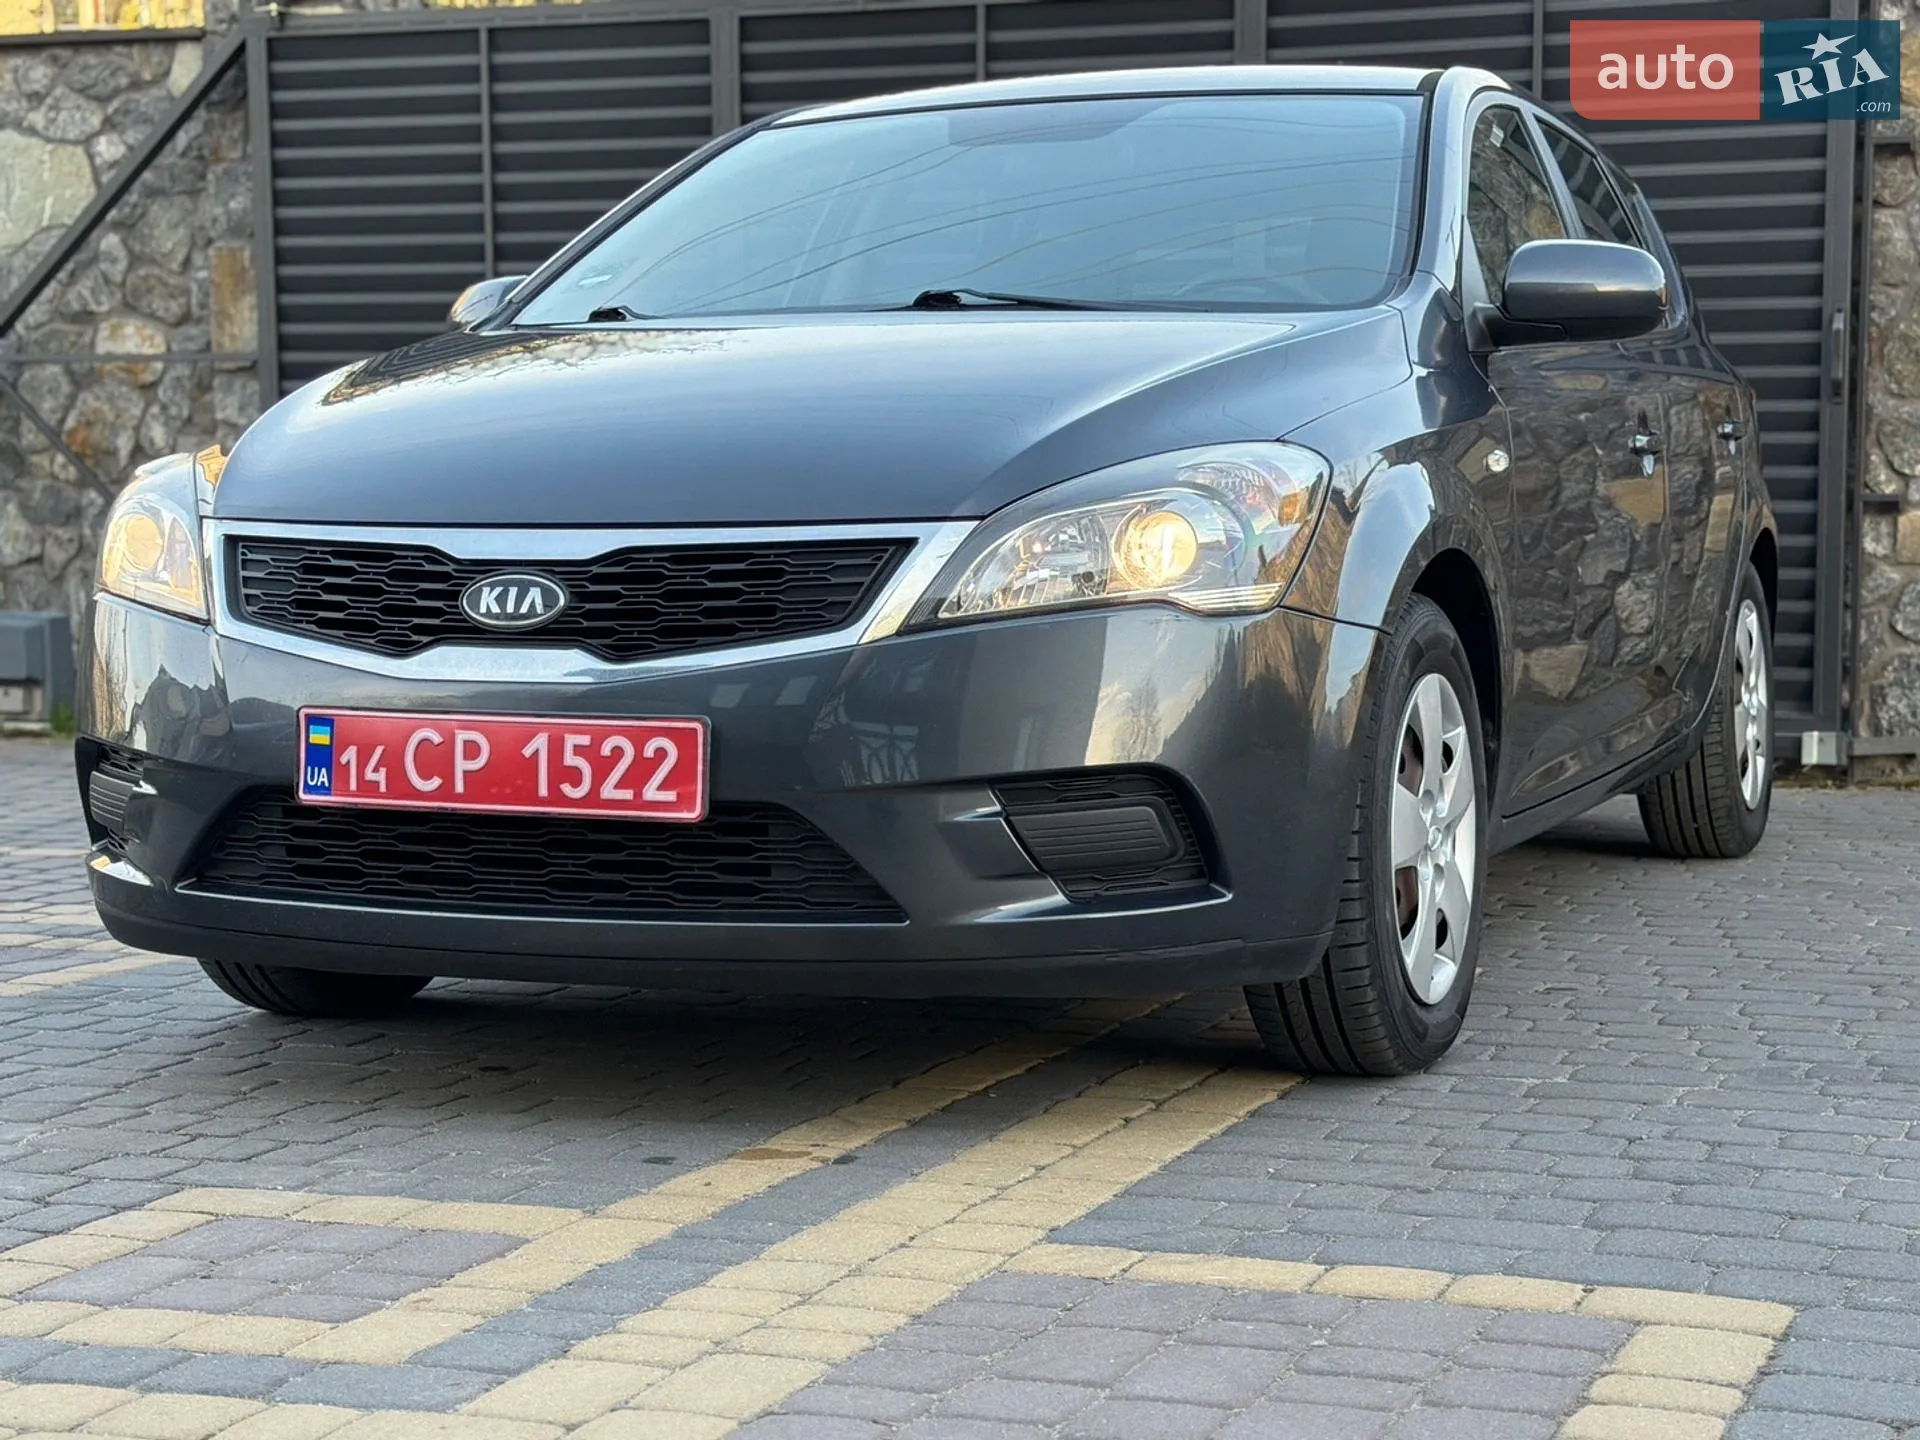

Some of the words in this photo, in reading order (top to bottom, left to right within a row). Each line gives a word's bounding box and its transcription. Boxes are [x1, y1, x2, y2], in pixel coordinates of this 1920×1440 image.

[479, 586, 545, 615] KIA
[307, 766, 329, 787] UA
[339, 745, 387, 793] 14
[404, 728, 491, 794] CP
[521, 732, 679, 802] 1522
